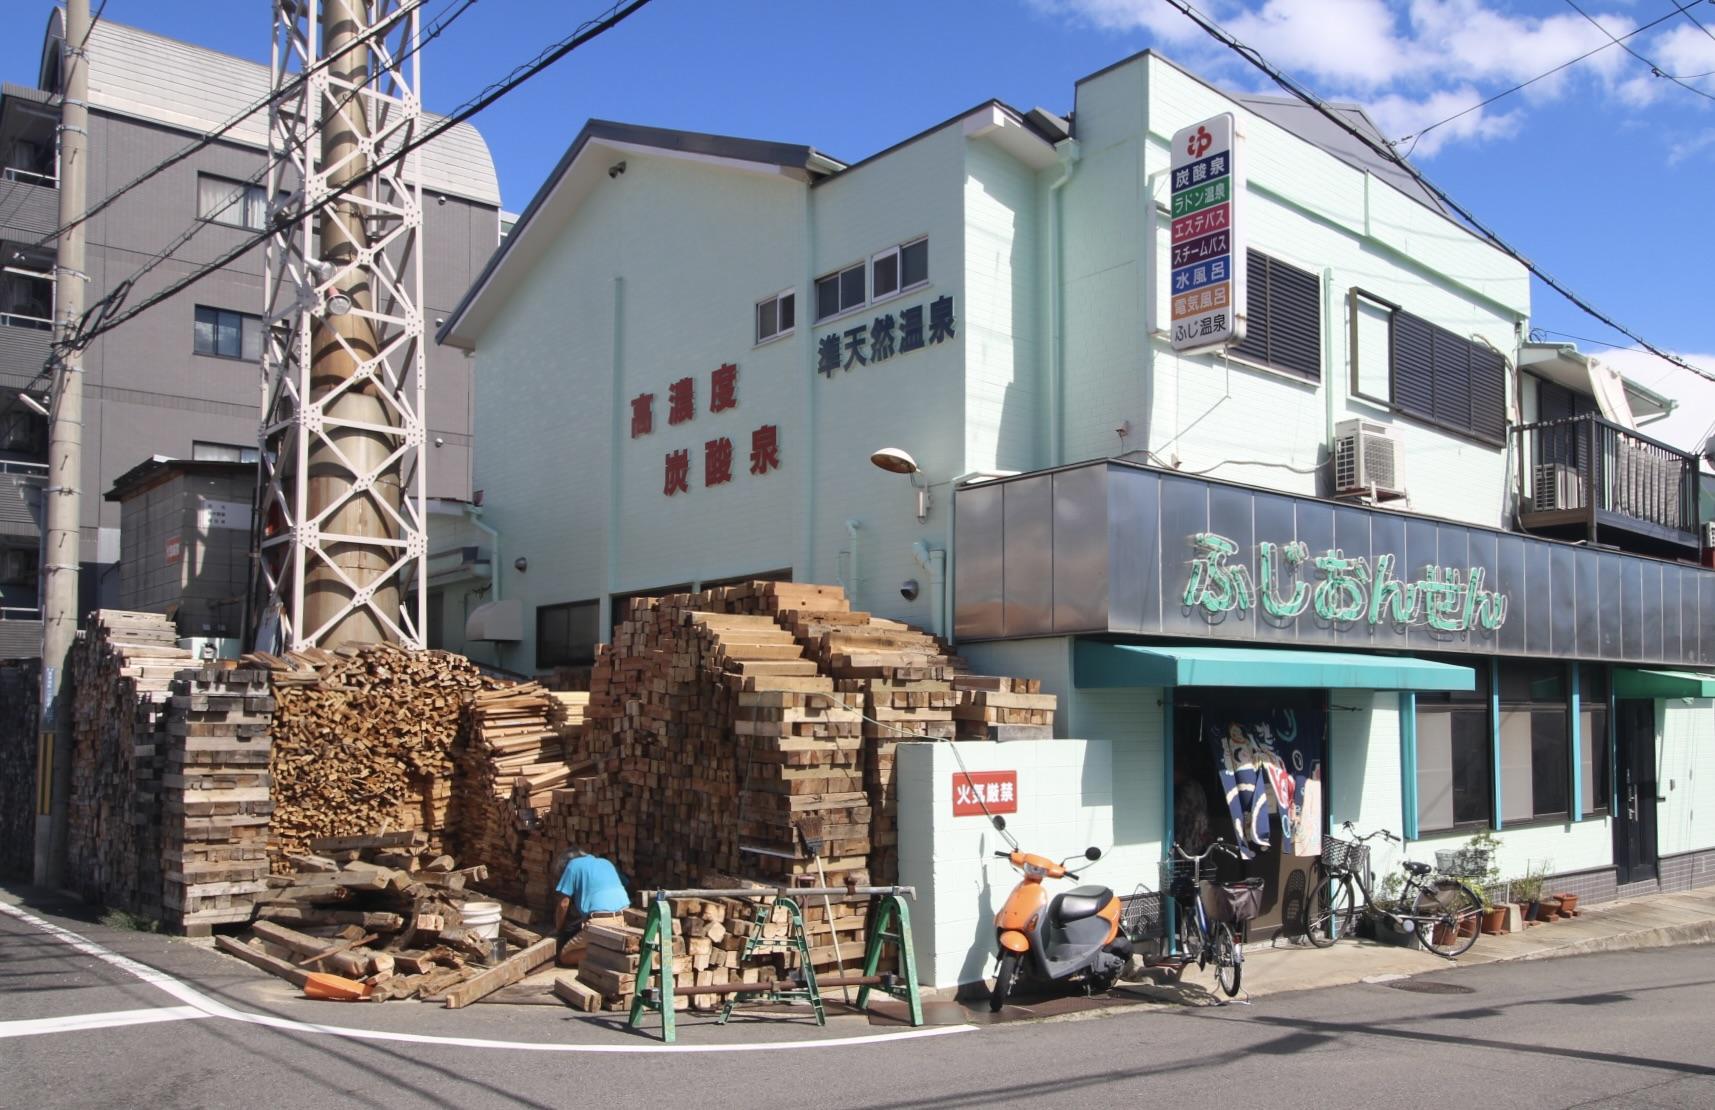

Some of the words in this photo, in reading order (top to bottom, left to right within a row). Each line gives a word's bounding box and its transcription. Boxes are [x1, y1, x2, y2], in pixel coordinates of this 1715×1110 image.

[1176, 157, 1225, 188] 炭酸泉
[1175, 183, 1225, 213] ラドン温泉
[1175, 209, 1225, 238] エステバス
[1174, 236, 1226, 265] スチームバス
[1176, 261, 1224, 289] 水風呂
[1175, 287, 1226, 315] 電気風呂
[817, 295, 956, 378] 準天然温泉
[1174, 314, 1226, 341] ふじ温泉
[631, 363, 738, 438] 高濃度
[664, 425, 780, 496] 炭酸泉
[1184, 533, 1507, 631] ふじおんせん
[957, 782, 1014, 805] 火気厳禁
